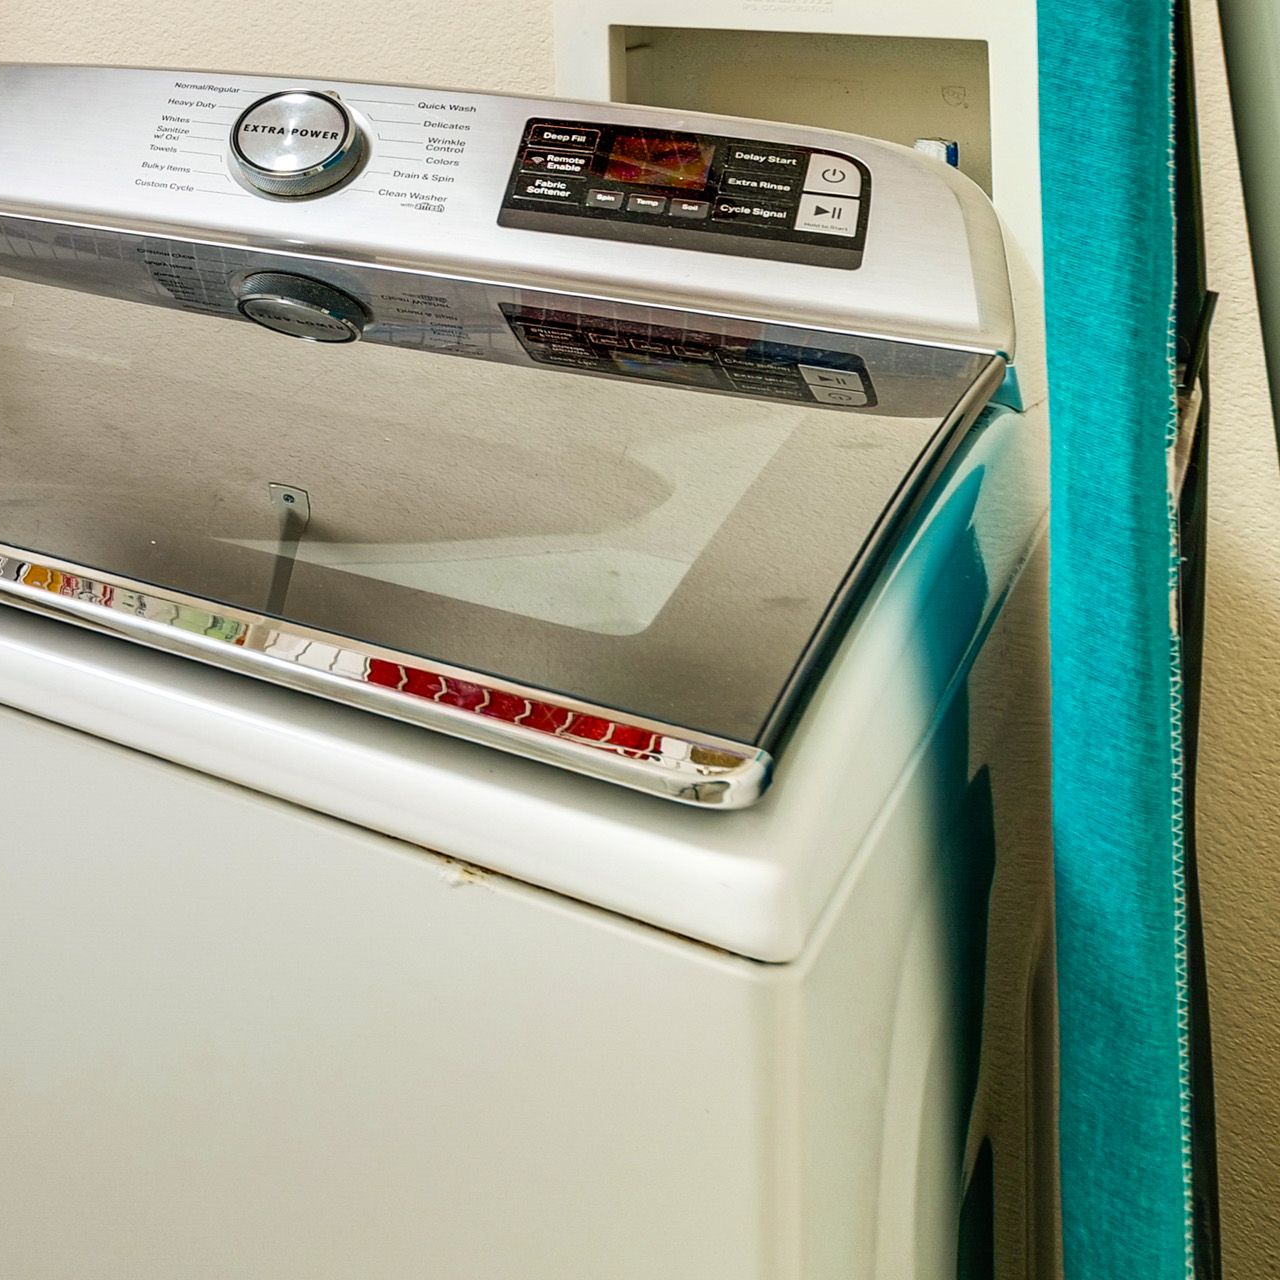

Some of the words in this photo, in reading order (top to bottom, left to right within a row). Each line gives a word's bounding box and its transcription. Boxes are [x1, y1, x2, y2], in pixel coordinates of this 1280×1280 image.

[174, 82, 240, 94] Normal/Regular
[168, 98, 195, 108] Heavy
[196, 101, 217, 109] Duty
[418, 101, 446, 110] Quick
[449, 104, 476, 113] Wash
[161, 115, 190, 124] Whites
[423, 120, 471, 131] Delicates
[156, 125, 190, 135] Sanitize
[243, 123, 285, 136] EXTRA
[291, 128, 340, 140] POWER
[428, 137, 466, 146] Wrinkle
[543, 131, 570, 142] Deep
[571, 135, 586, 143] Fill
[149, 144, 177, 153] Towels
[425, 144, 464, 153] Control
[426, 157, 460, 166] Colors
[546, 154, 586, 166] Remote
[735, 151, 767, 163] Delay
[768, 156, 798, 166] Start
[141, 161, 165, 171] Bulky
[167, 164, 191, 174] Items
[546, 162, 581, 172] Enable
[393, 170, 420, 179] Drain
[431, 175, 455, 183] Spin
[135, 179, 168, 188] Custom
[170, 182, 195, 192] Cycle
[534, 179, 567, 190] Fabric
[728, 178, 757, 187] Extra
[760, 181, 791, 192] Rinse
[378, 189, 407, 198] Clean
[409, 192, 448, 202] Washer
[526, 186, 571, 198] Softener
[596, 194, 615, 202] Spin
[636, 198, 659, 208] Temp
[682, 204, 699, 212] Soil
[720, 204, 751, 215] Cycle
[752, 207, 787, 219] Signal
